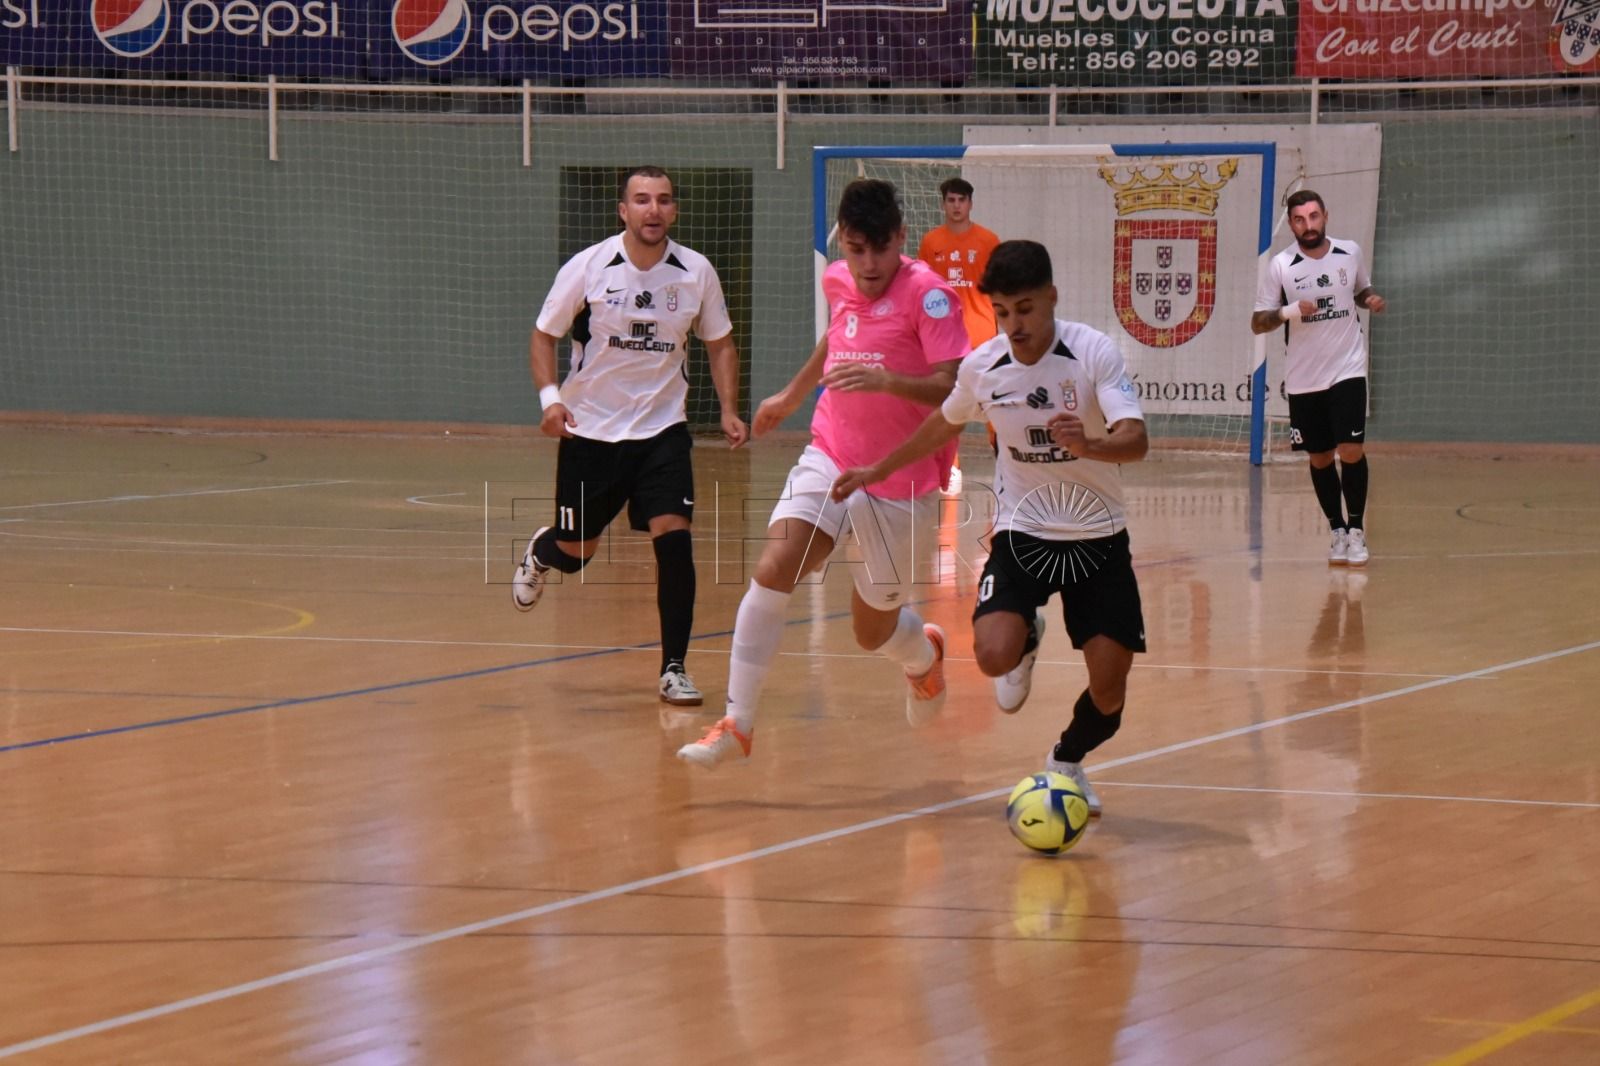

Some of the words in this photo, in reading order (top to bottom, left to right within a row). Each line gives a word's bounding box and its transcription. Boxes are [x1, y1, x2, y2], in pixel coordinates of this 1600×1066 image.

[181, 0, 339, 47] pepsi
[482, 3, 639, 51] pepsi
[994, 29, 1115, 47] Muebles
[1133, 31, 1150, 49] y
[1171, 26, 1275, 45] Cocina
[1316, 27, 1379, 63] Con
[1390, 26, 1420, 54] el
[1427, 20, 1521, 56] Ceutí
[1007, 52, 1075, 70] Telf.:
[1086, 51, 1136, 69] 856
[1147, 50, 1197, 68] 206
[1208, 48, 1260, 67] 292
[631, 322, 655, 338] MC
[844, 314, 858, 339] 8
[560, 505, 575, 531] 11
[977, 574, 995, 607] 0
